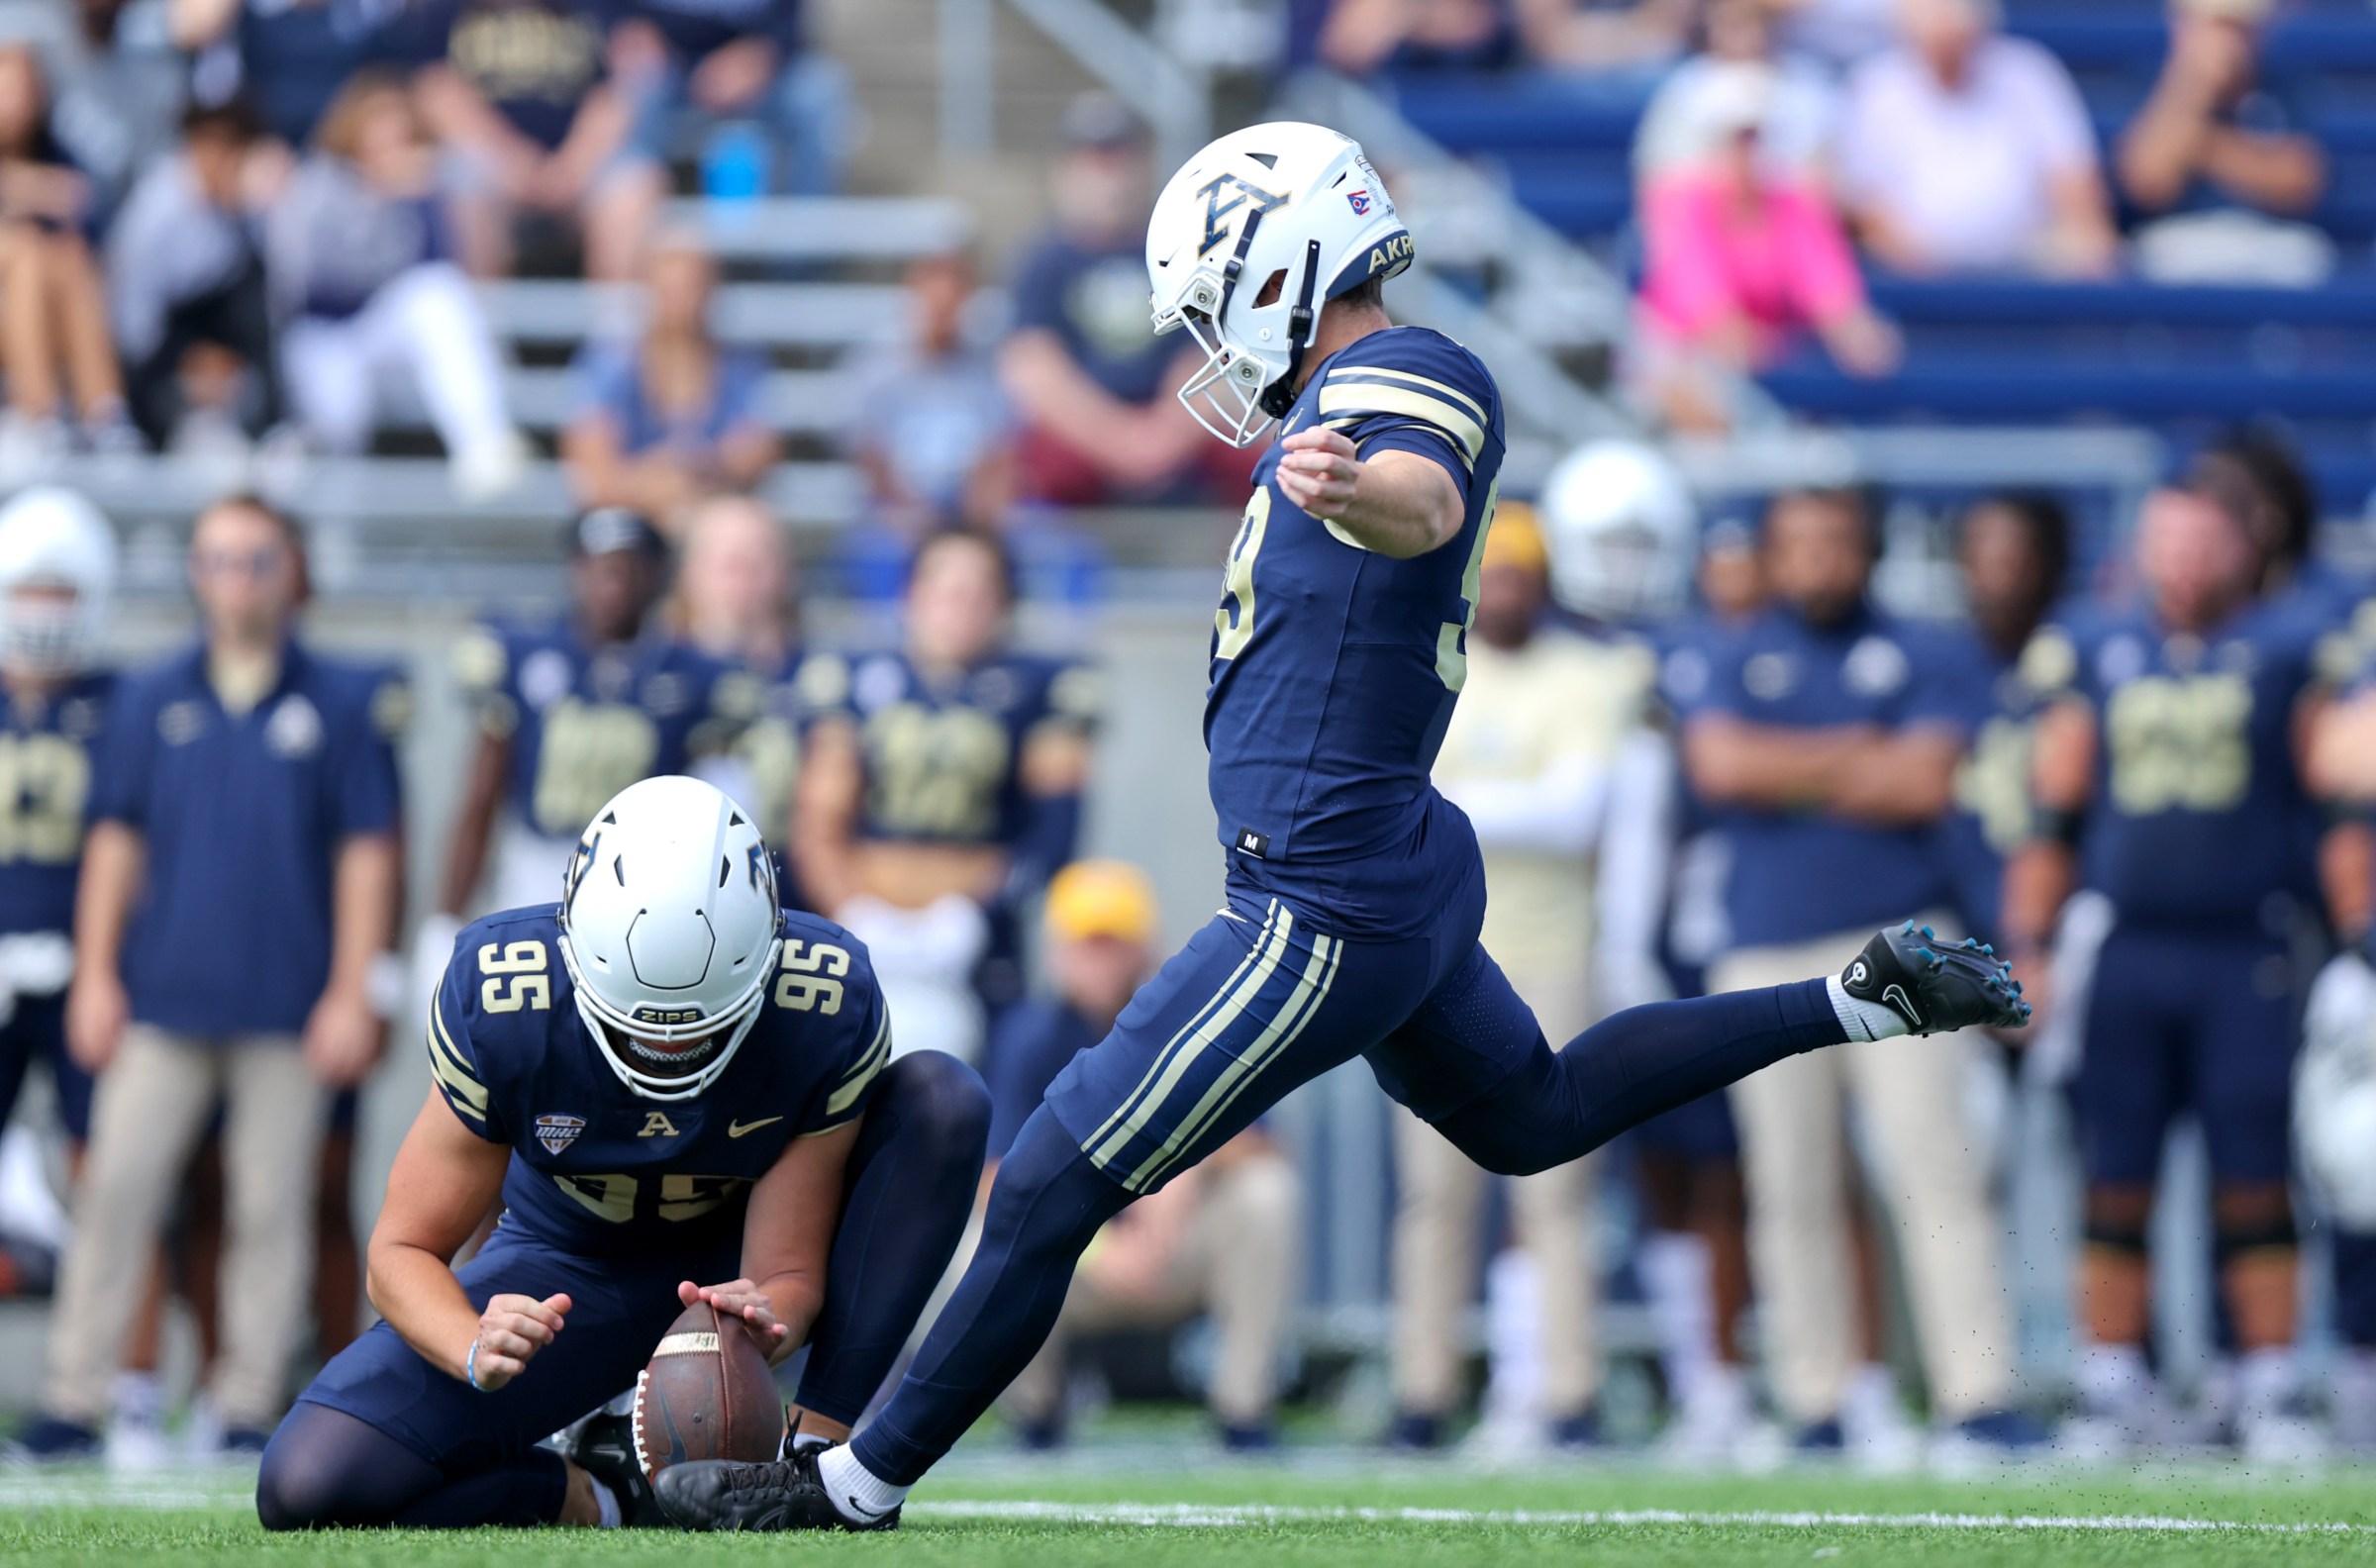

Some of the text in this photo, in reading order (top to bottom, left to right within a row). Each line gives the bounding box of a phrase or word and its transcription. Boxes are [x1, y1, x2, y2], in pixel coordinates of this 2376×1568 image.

[1368, 235, 1415, 274] AKR
[1244, 833, 1258, 850] M
[478, 939, 550, 1015] 95
[774, 938, 850, 1016] 95
[642, 1010, 697, 1023] ZIPS
[536, 1126, 582, 1138] MAC
[637, 1111, 680, 1137] A
